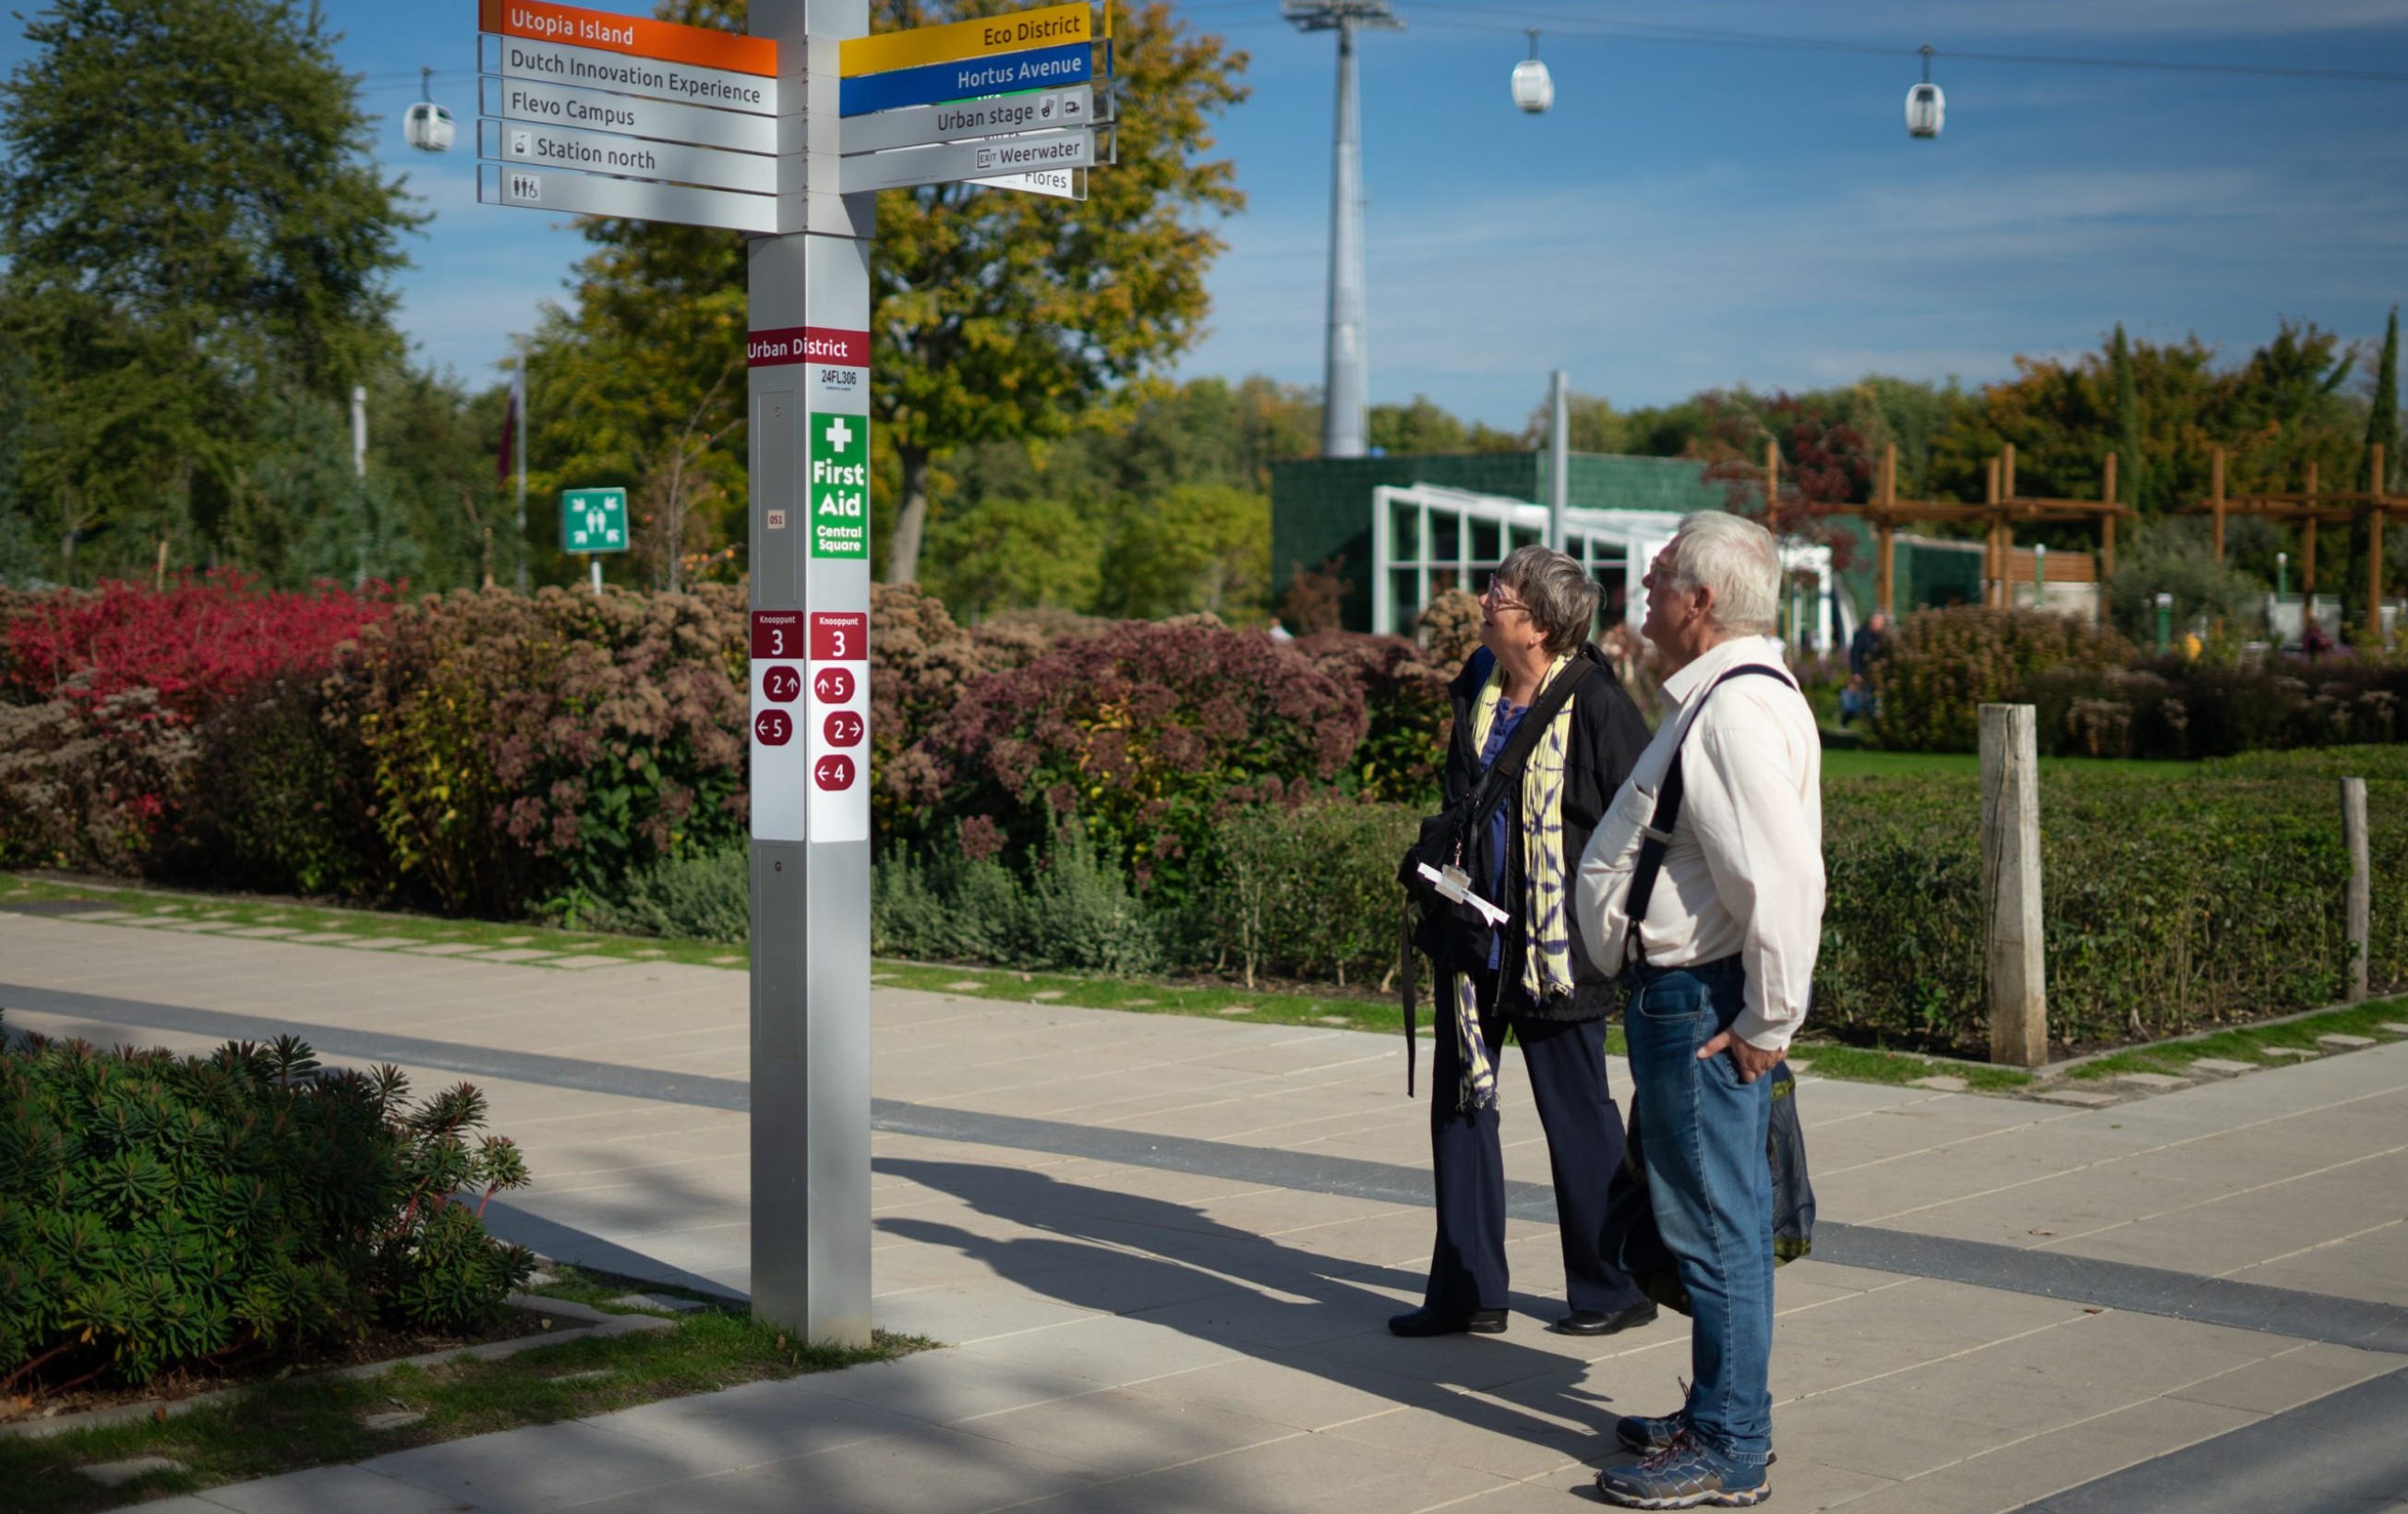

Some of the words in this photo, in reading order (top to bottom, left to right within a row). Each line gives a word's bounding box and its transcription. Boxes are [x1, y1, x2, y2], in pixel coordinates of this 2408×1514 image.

[512, 7, 574, 36] Utopia
[580, 19, 633, 45] Island
[984, 29, 1012, 45] Eco
[1017, 16, 1081, 41] District
[512, 49, 564, 74] Dutch
[571, 57, 663, 89] Innovation
[669, 73, 761, 103] Experience
[958, 67, 1014, 89] Hortus
[1018, 57, 1081, 79] Avenue
[512, 92, 560, 115] Flevo
[566, 100, 634, 126] Campus
[937, 106, 984, 131] Urban
[989, 105, 1034, 125] stage
[537, 138, 602, 163] Station
[608, 150, 656, 169] north
[980, 153, 997, 163] EXIT
[1000, 142, 1080, 164] Weerwater
[1025, 172, 1066, 189] Flores
[748, 340, 788, 358] Urban
[793, 337, 848, 357] District
[821, 369, 857, 385] 24FL306
[813, 458, 865, 486] First
[818, 489, 861, 516] Aid
[769, 515, 783, 524] 051
[817, 525, 862, 537] Central
[819, 539, 861, 552] Square
[759, 616, 796, 625] Knooppunt
[819, 617, 859, 627] Knooppunt
[771, 629, 784, 655] 3
[832, 631, 846, 657] 3
[773, 675, 783, 694] 2
[834, 677, 845, 696] 5
[773, 719, 783, 738] 5
[834, 720, 845, 739] 2
[834, 763, 845, 783] 4
